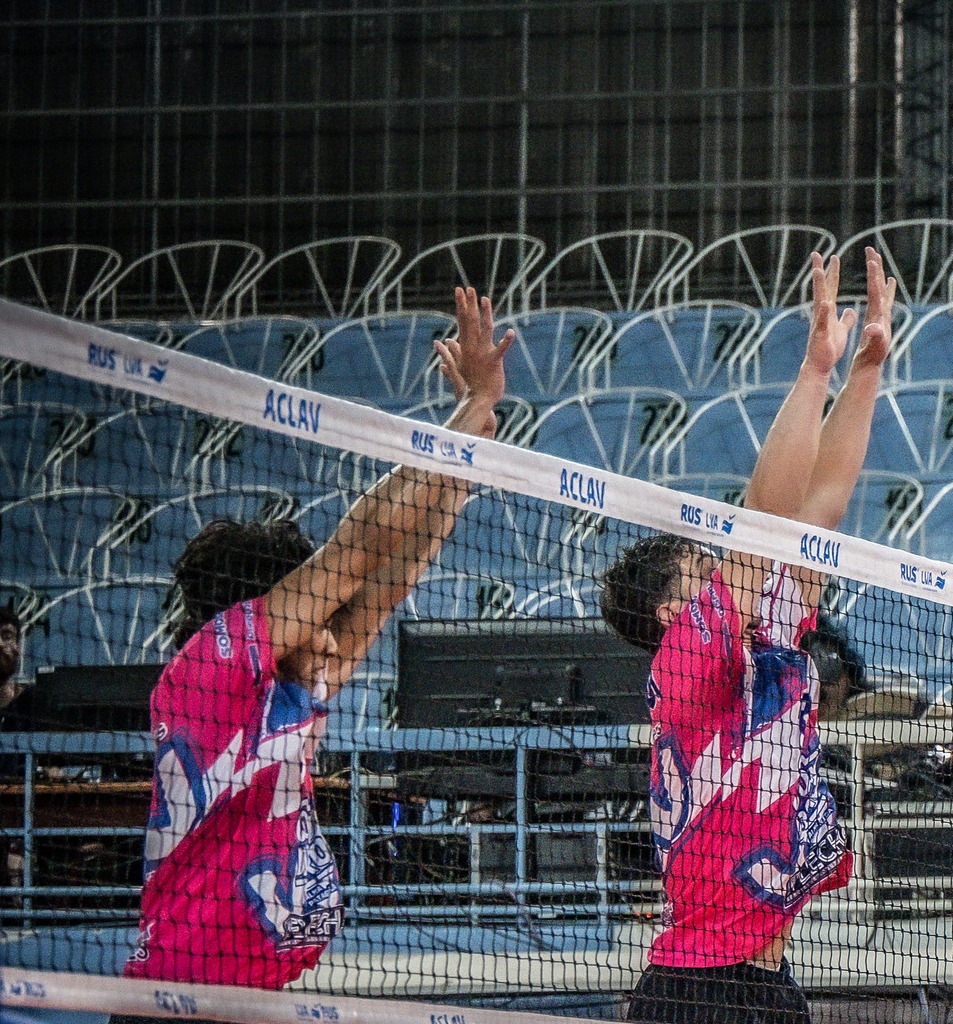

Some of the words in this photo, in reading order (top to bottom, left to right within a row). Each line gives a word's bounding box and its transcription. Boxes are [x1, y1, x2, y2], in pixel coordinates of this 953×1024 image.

[87, 342, 117, 370] RUS
[263, 388, 321, 434] ACLAV
[411, 430, 434, 454] RUS
[559, 468, 606, 509] ACLAV
[681, 503, 702, 526] RUS
[705, 512, 719, 530] LVA
[800, 533, 841, 568] ACLAV
[901, 562, 917, 584] RUS
[921, 570, 933, 586] LVA
